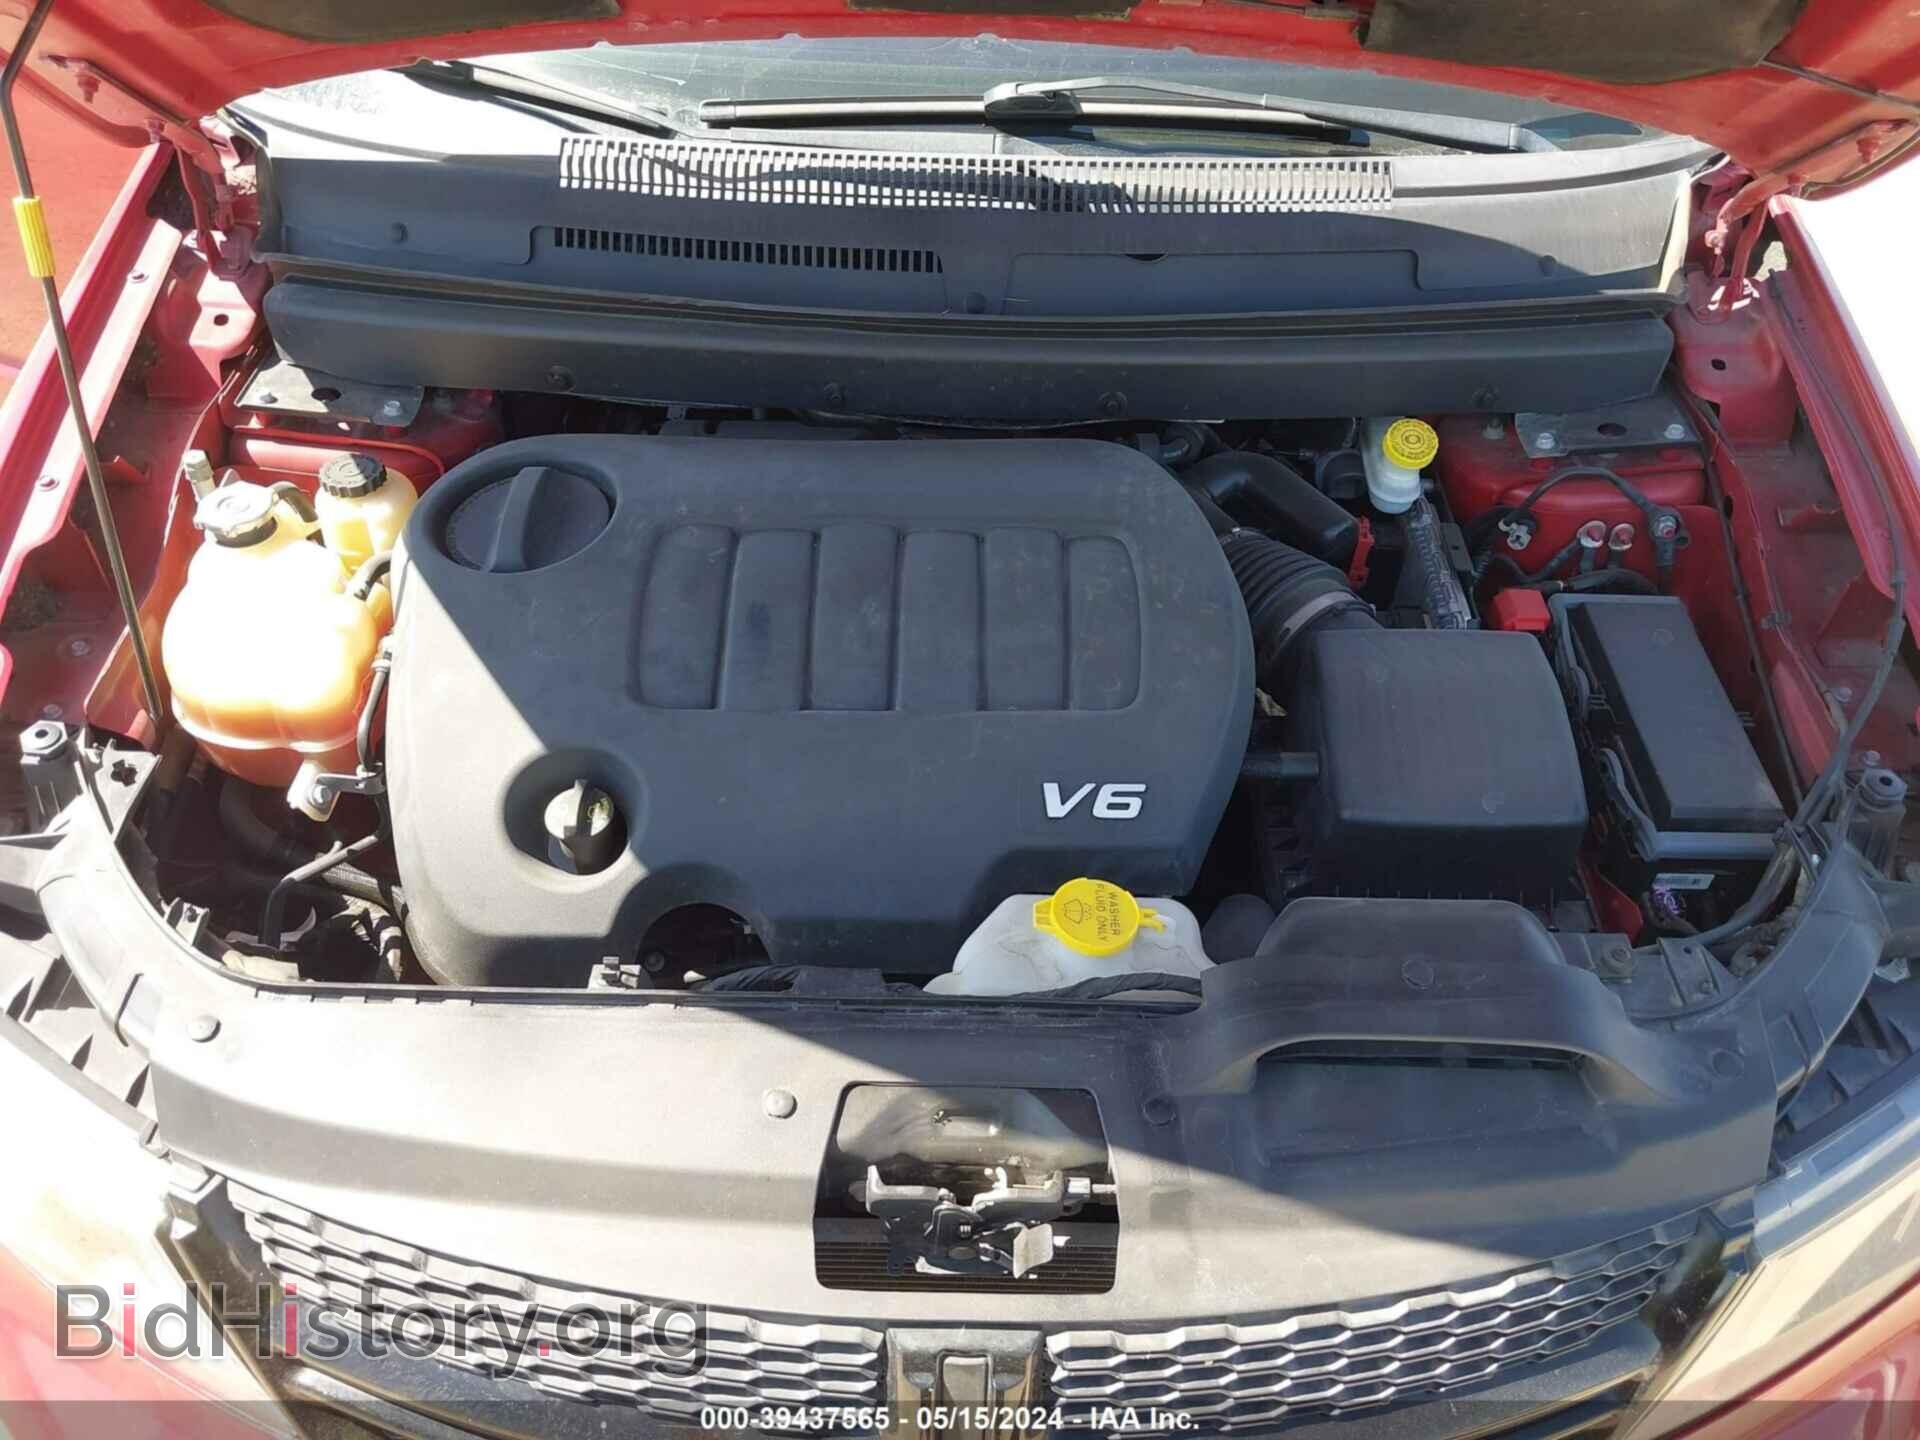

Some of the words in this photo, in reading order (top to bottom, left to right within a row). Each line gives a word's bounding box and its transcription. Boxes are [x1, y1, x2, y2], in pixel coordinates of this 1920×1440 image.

[1043, 782, 1147, 819] V6
[1095, 883, 1106, 912] FLUID
[1109, 891, 1121, 936] WASHER
